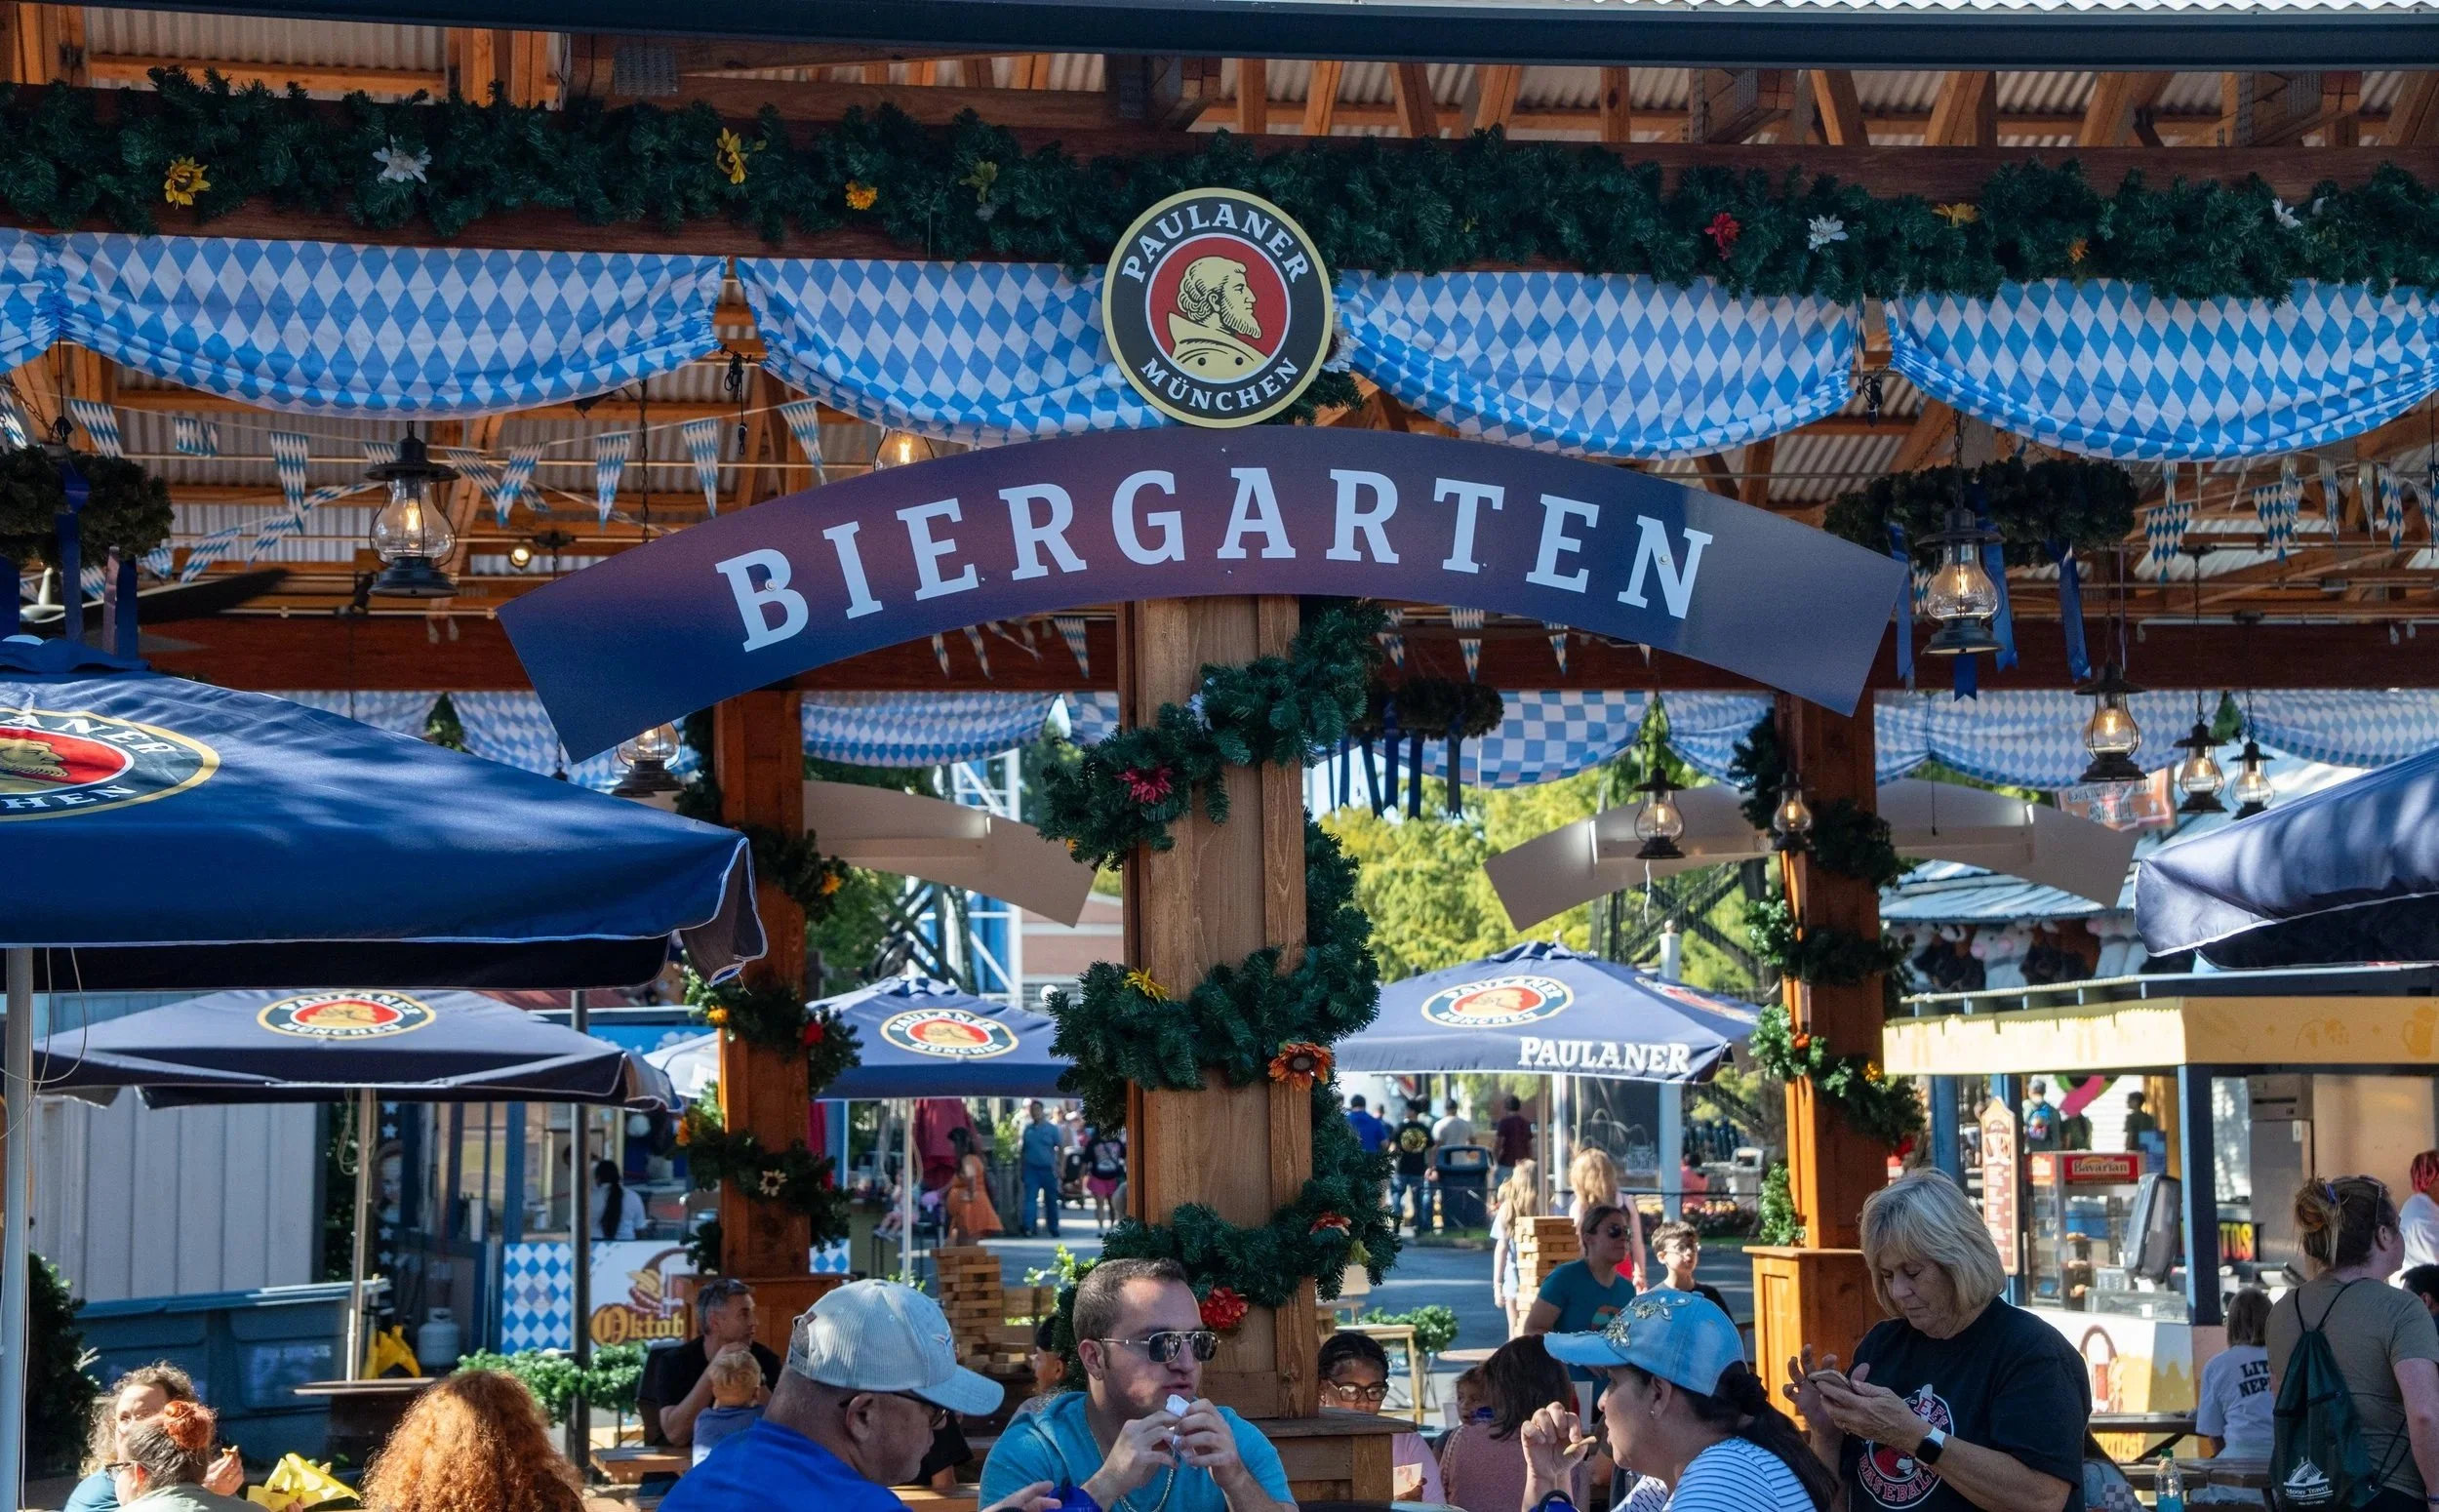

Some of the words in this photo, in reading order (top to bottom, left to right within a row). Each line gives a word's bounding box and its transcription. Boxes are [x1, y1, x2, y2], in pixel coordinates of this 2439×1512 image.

[1122, 203, 1309, 283] PAULANER
[1140, 357, 1299, 411] MÜNCHEN
[715, 467, 1713, 653] BIERGARTEN
[1518, 1037, 1691, 1073] PAULANER
[2073, 1161, 2128, 1173] Bavarian
[2306, 1484, 2329, 1494] Travel
